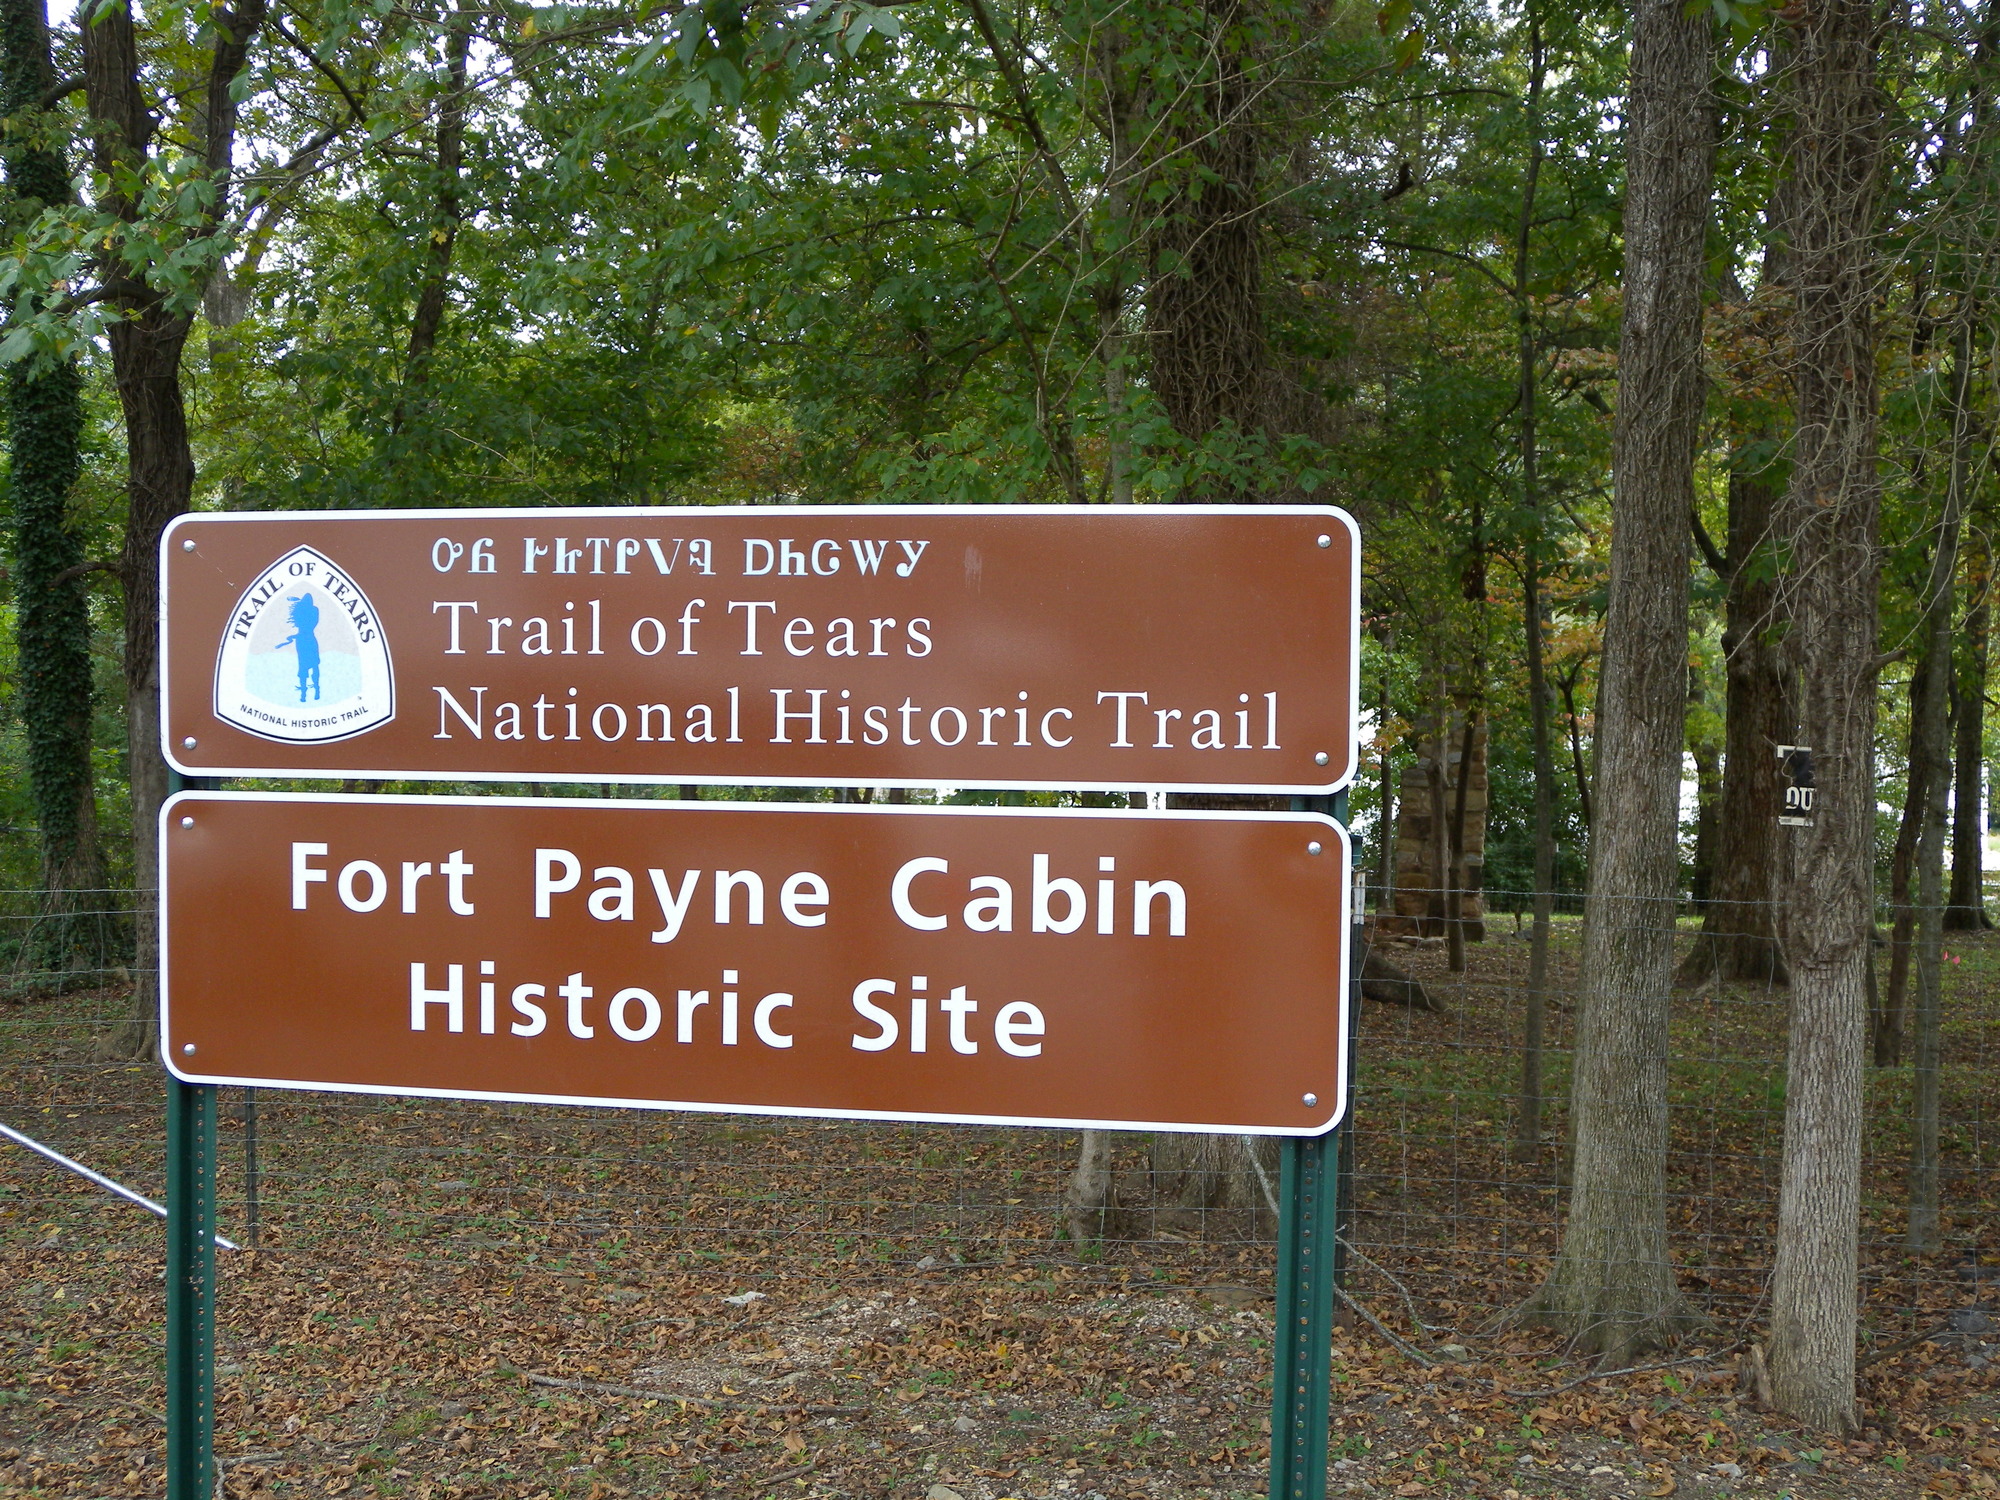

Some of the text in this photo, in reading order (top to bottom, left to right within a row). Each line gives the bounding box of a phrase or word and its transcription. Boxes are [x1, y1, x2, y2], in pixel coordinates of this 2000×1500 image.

[232, 562, 376, 644] TRAIL OF TEARS
[433, 598, 933, 658] Trail of Tears
[240, 703, 369, 728] NATIONAL HISTORIC TRAIL
[432, 686, 1281, 750] National Historic Trail
[292, 842, 1187, 944] Fort Payne Cabin
[410, 960, 1046, 1058] Historic Site
